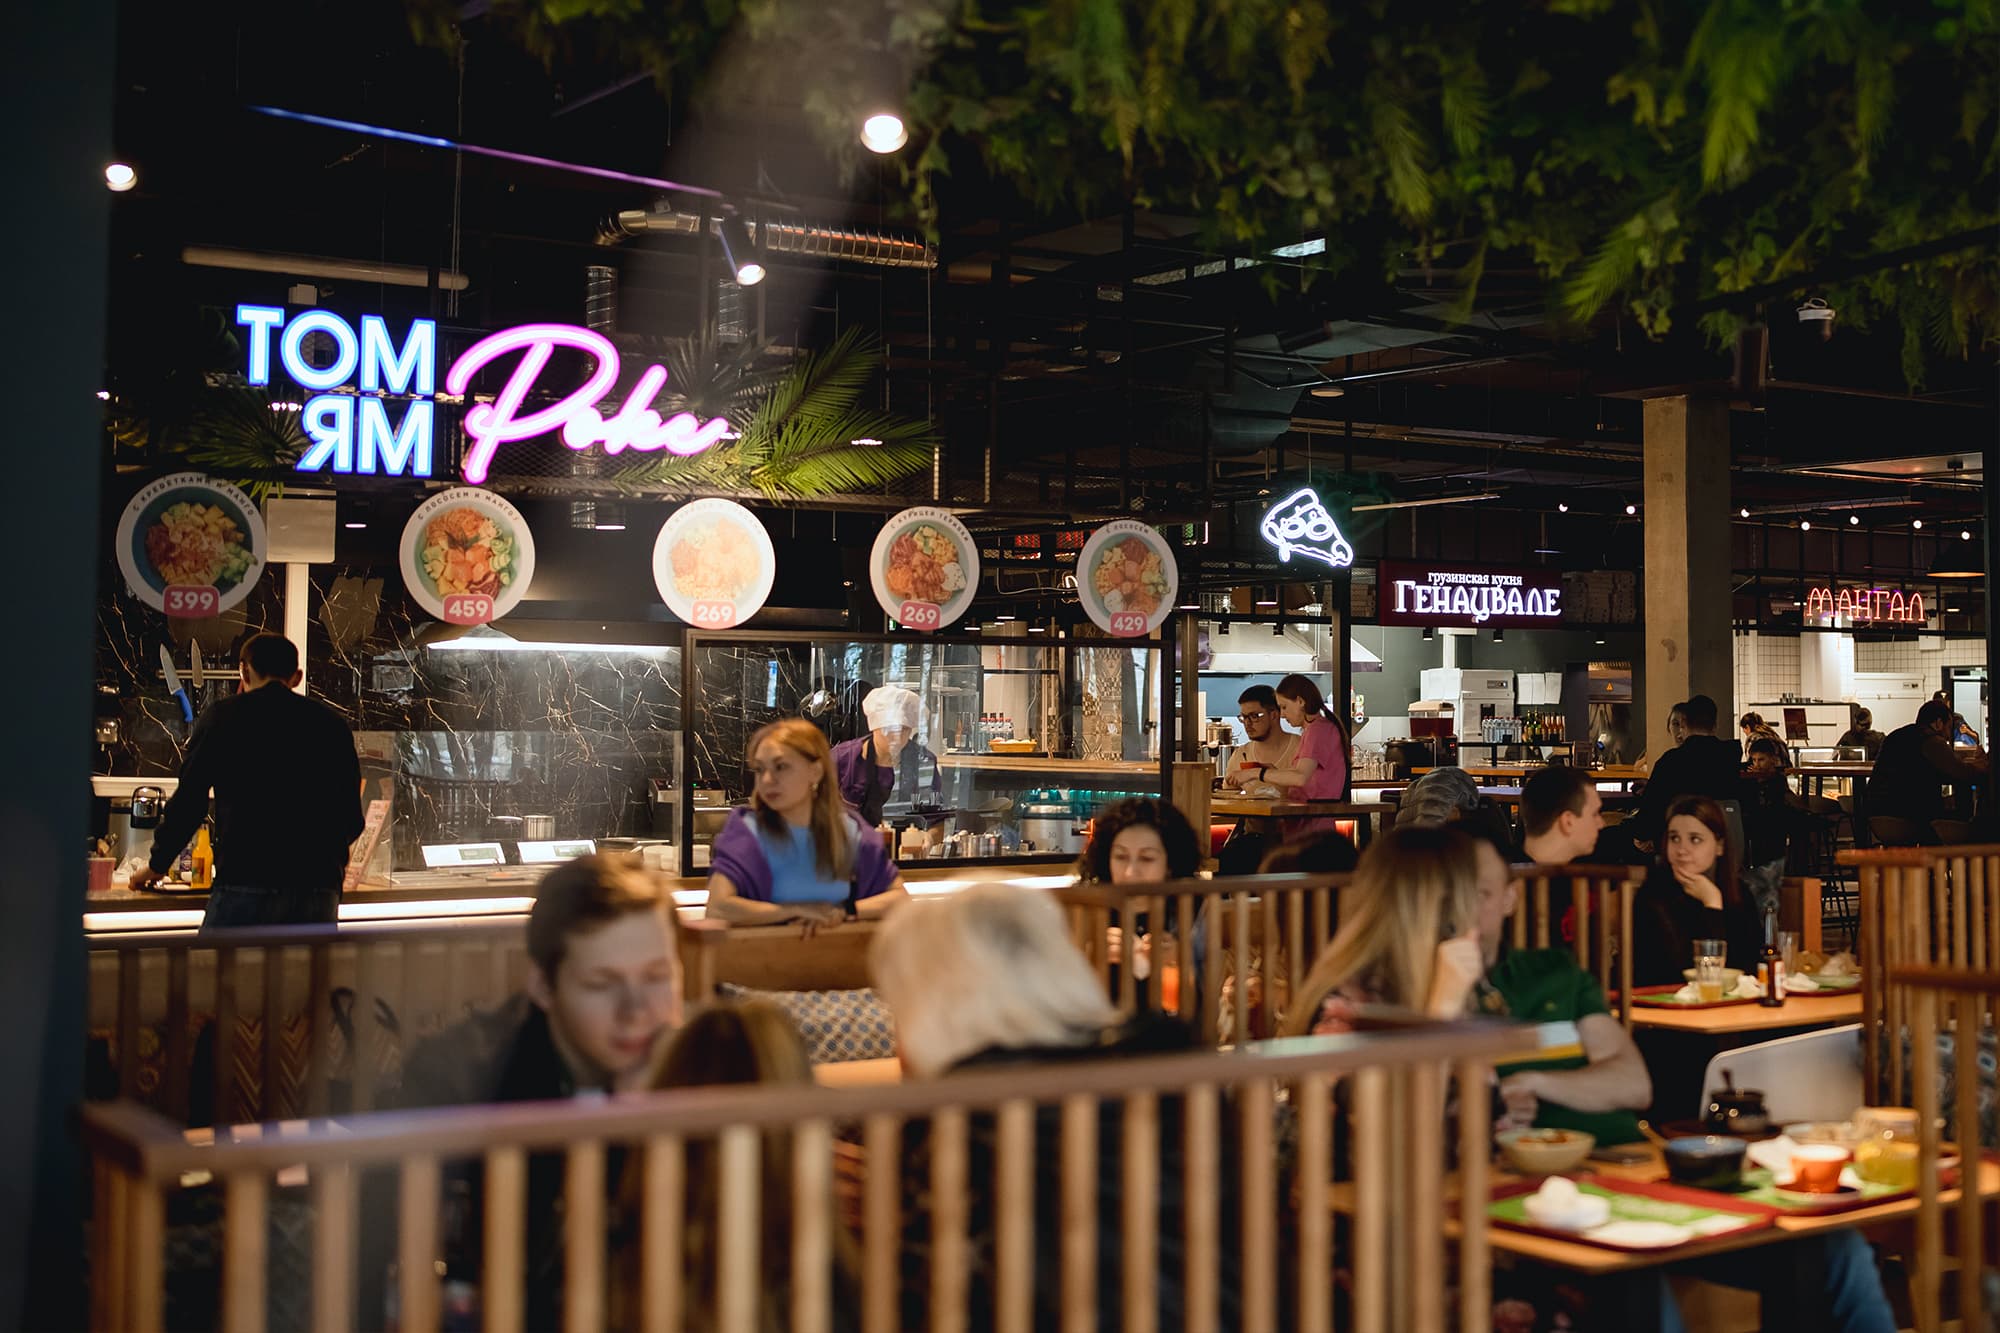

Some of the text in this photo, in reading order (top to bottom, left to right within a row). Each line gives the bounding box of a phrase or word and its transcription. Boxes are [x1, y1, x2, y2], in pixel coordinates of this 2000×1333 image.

[237, 304, 436, 396] ТОМ
[445, 323, 729, 485] Poke
[295, 393, 434, 477] ЯМ
[1428, 572, 1523, 587] грузинская кухня
[170, 592, 214, 610] 399
[448, 600, 489, 617] 459
[1806, 587, 1925, 621] МАНГАЛ
[696, 605, 733, 622] 269
[904, 606, 937, 624] 269
[1114, 616, 1144, 631] 429
